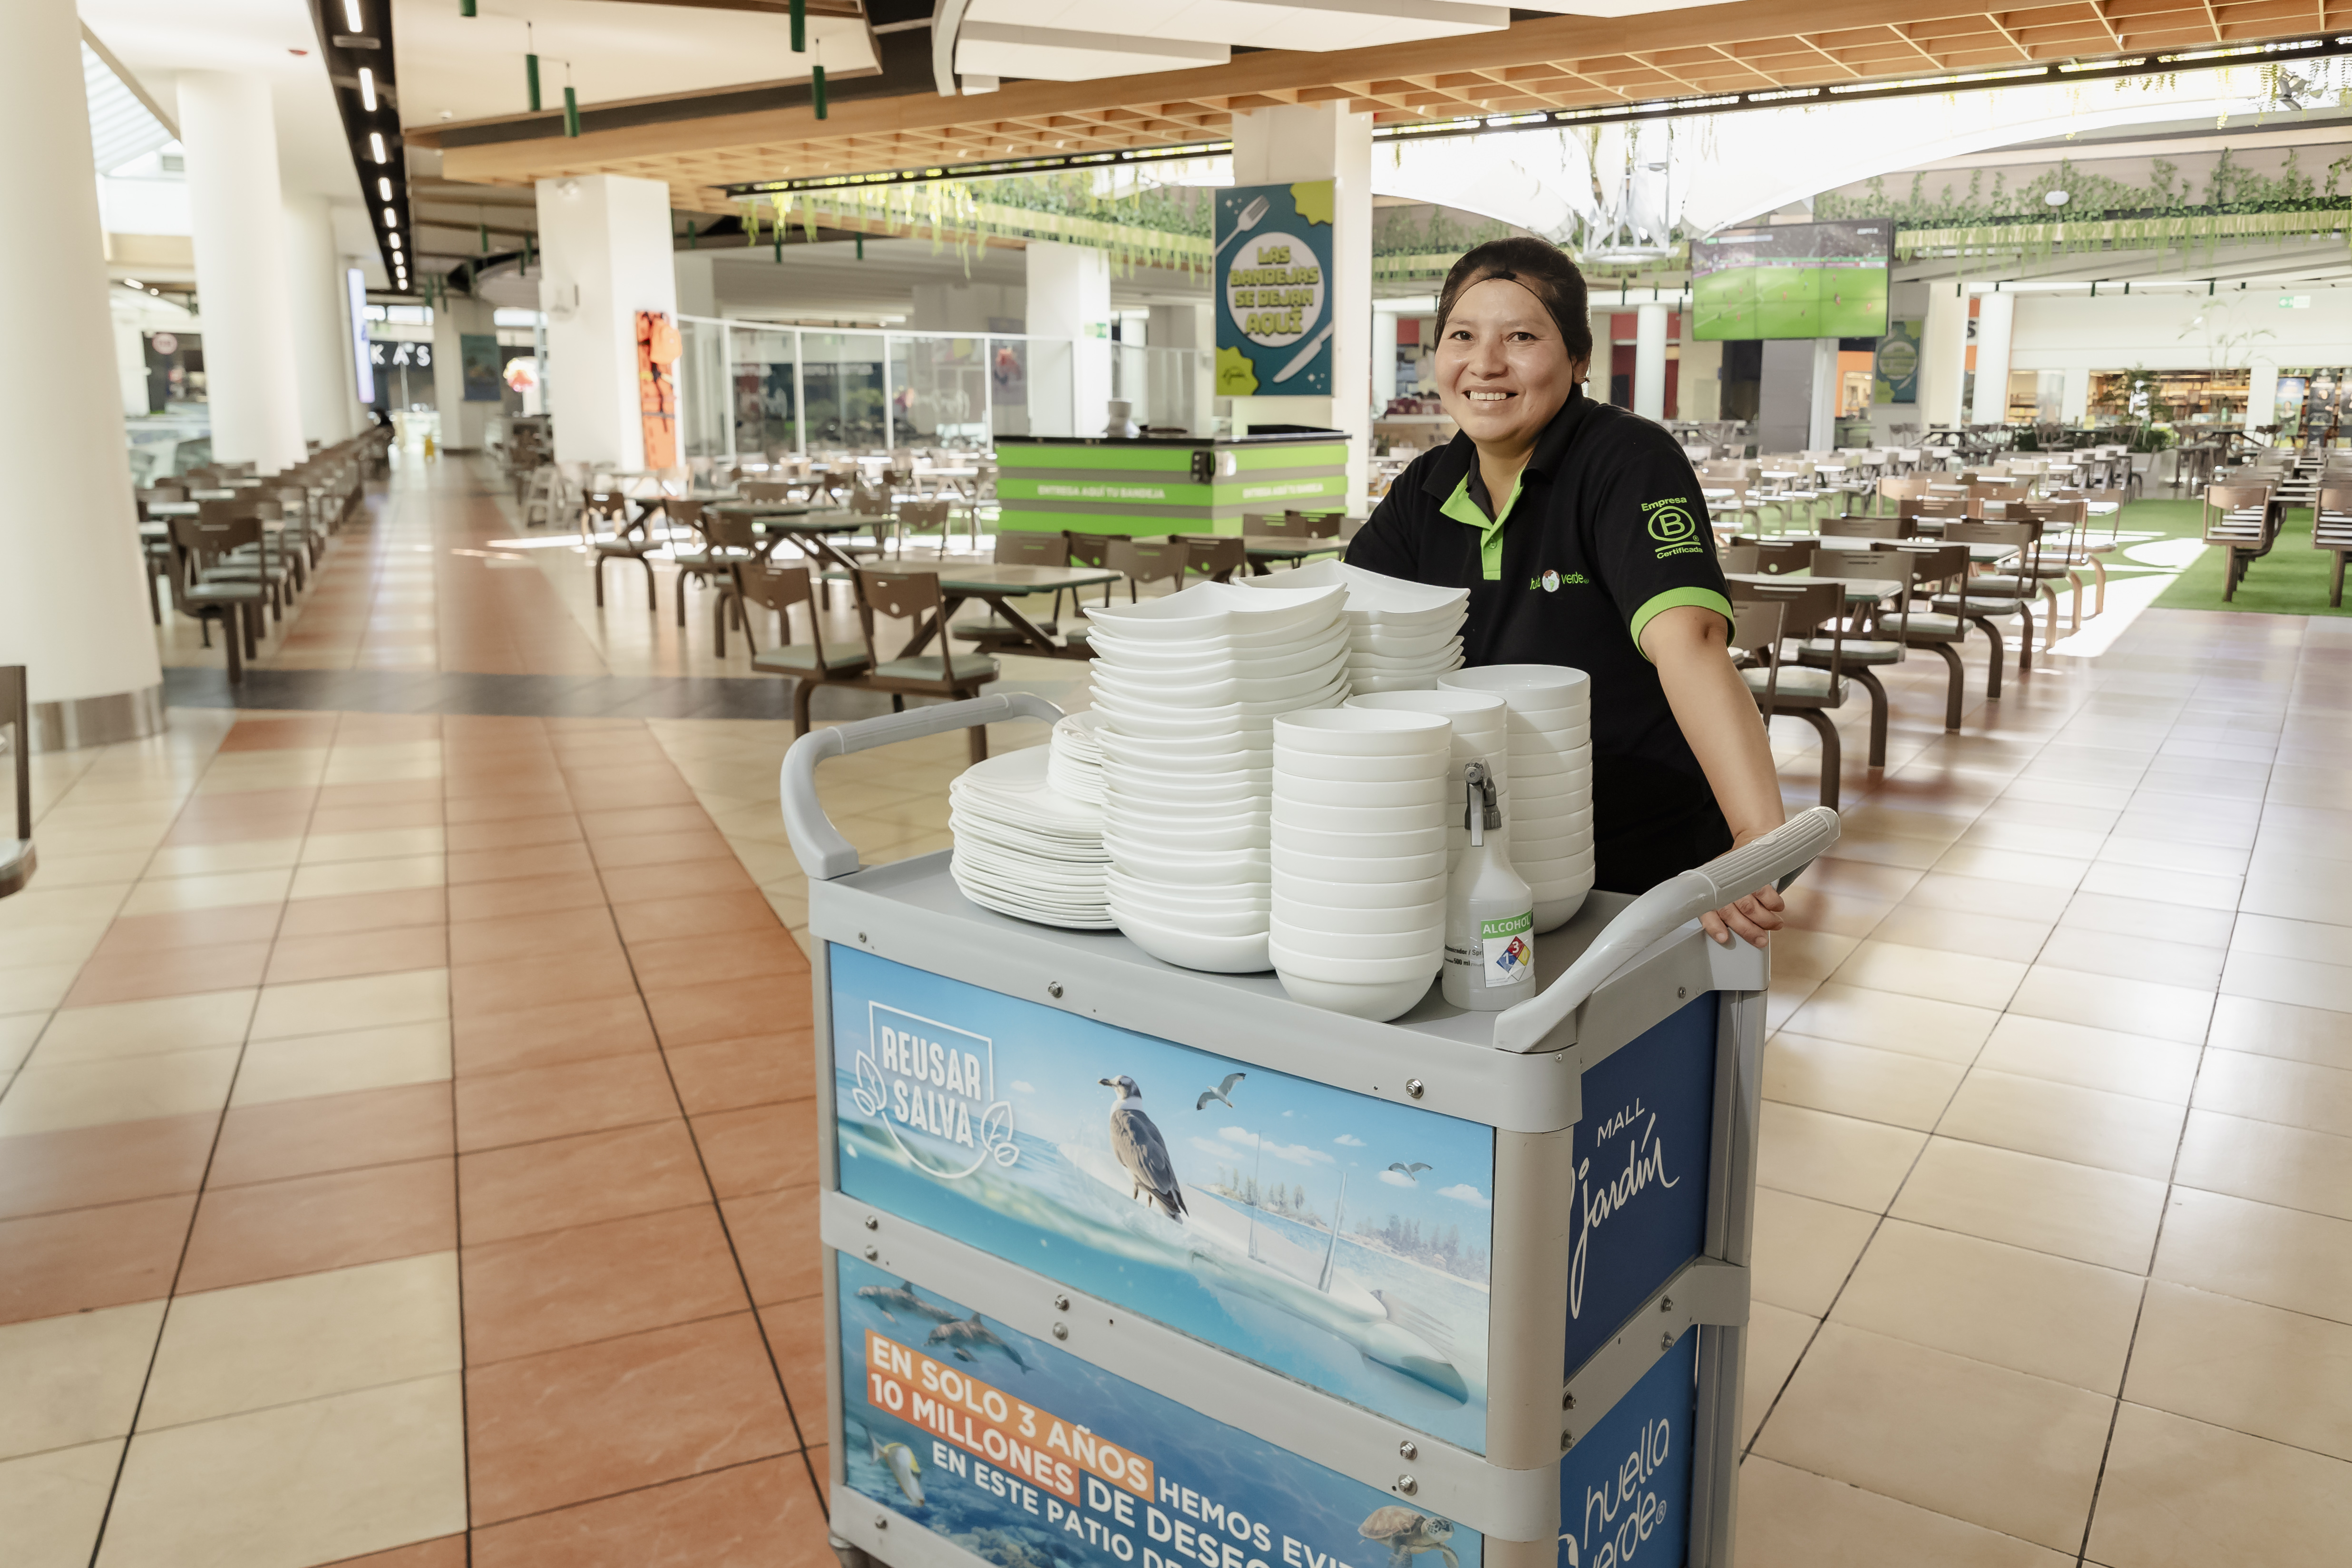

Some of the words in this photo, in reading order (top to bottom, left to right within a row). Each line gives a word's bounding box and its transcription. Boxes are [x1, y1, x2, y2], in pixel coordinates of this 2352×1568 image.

[1258, 246, 1290, 264] LAS
[1230, 267, 1318, 287] BANDEJAS
[1235, 290, 1254, 308] SE
[1258, 289, 1313, 307] DEJAN
[1246, 307, 1302, 336] AQUÍ
[1641, 497, 1687, 511] Empresa
[1659, 513, 1685, 536] B
[1657, 547, 1703, 559] Certificada
[1561, 572, 1583, 584] verde
[1483, 915, 1530, 934] ALCOHOL
[1503, 952, 1509, 964] 1
[1512, 941, 1519, 954] 3
[1522, 950, 1528, 961] 0
[882, 1025, 981, 1101] REUSAR
[893, 1079, 974, 1149] SALVA
[1597, 1098, 1645, 1148] MALL
[1571, 1112, 1680, 1319] jardín
[871, 1373, 903, 1411] 10
[912, 1391, 1074, 1496] MILLONES
[1087, 1476, 1135, 1528] DE
[872, 1335, 912, 1380] EN
[921, 1359, 1007, 1423] SOLO
[1017, 1403, 1036, 1438] 3
[1046, 1420, 1148, 1492] AÑOS
[1159, 1476, 1272, 1552] HEMOS
[1584, 1418, 1669, 1550] huella
[932, 1441, 966, 1478] EN
[975, 1462, 1039, 1516] ESTE
[1047, 1498, 1133, 1561] PATIO
